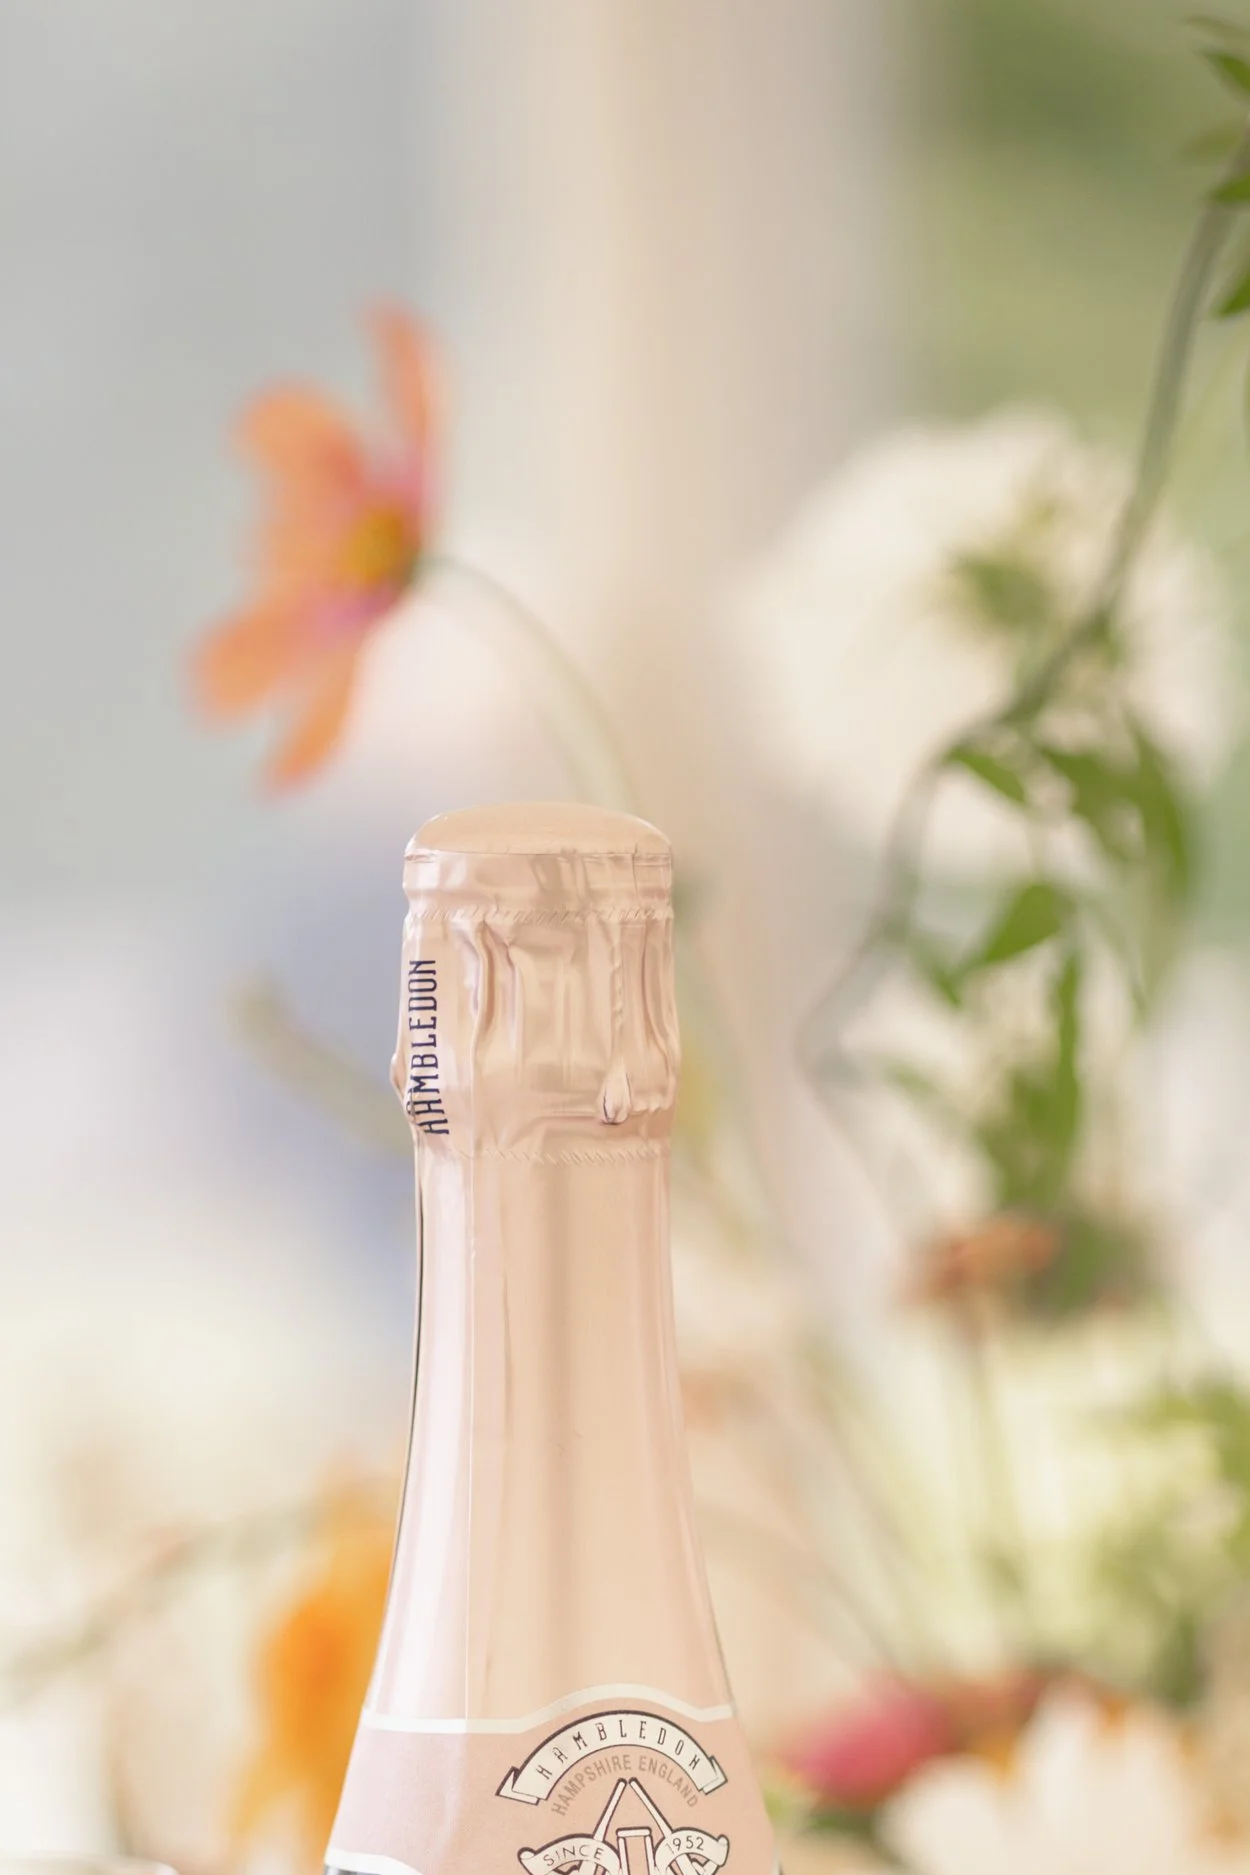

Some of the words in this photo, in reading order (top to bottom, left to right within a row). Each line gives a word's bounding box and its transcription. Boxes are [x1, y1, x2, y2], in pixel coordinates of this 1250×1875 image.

[406, 959, 450, 1136] HAMBLEDON
[535, 1719, 701, 1780] HAMBLEDON
[551, 1754, 633, 1816] HAMPSHIRE
[638, 1755, 698, 1808] ENGLAND
[543, 1844, 604, 1867] SINCE
[665, 1835, 705, 1855] 1952
